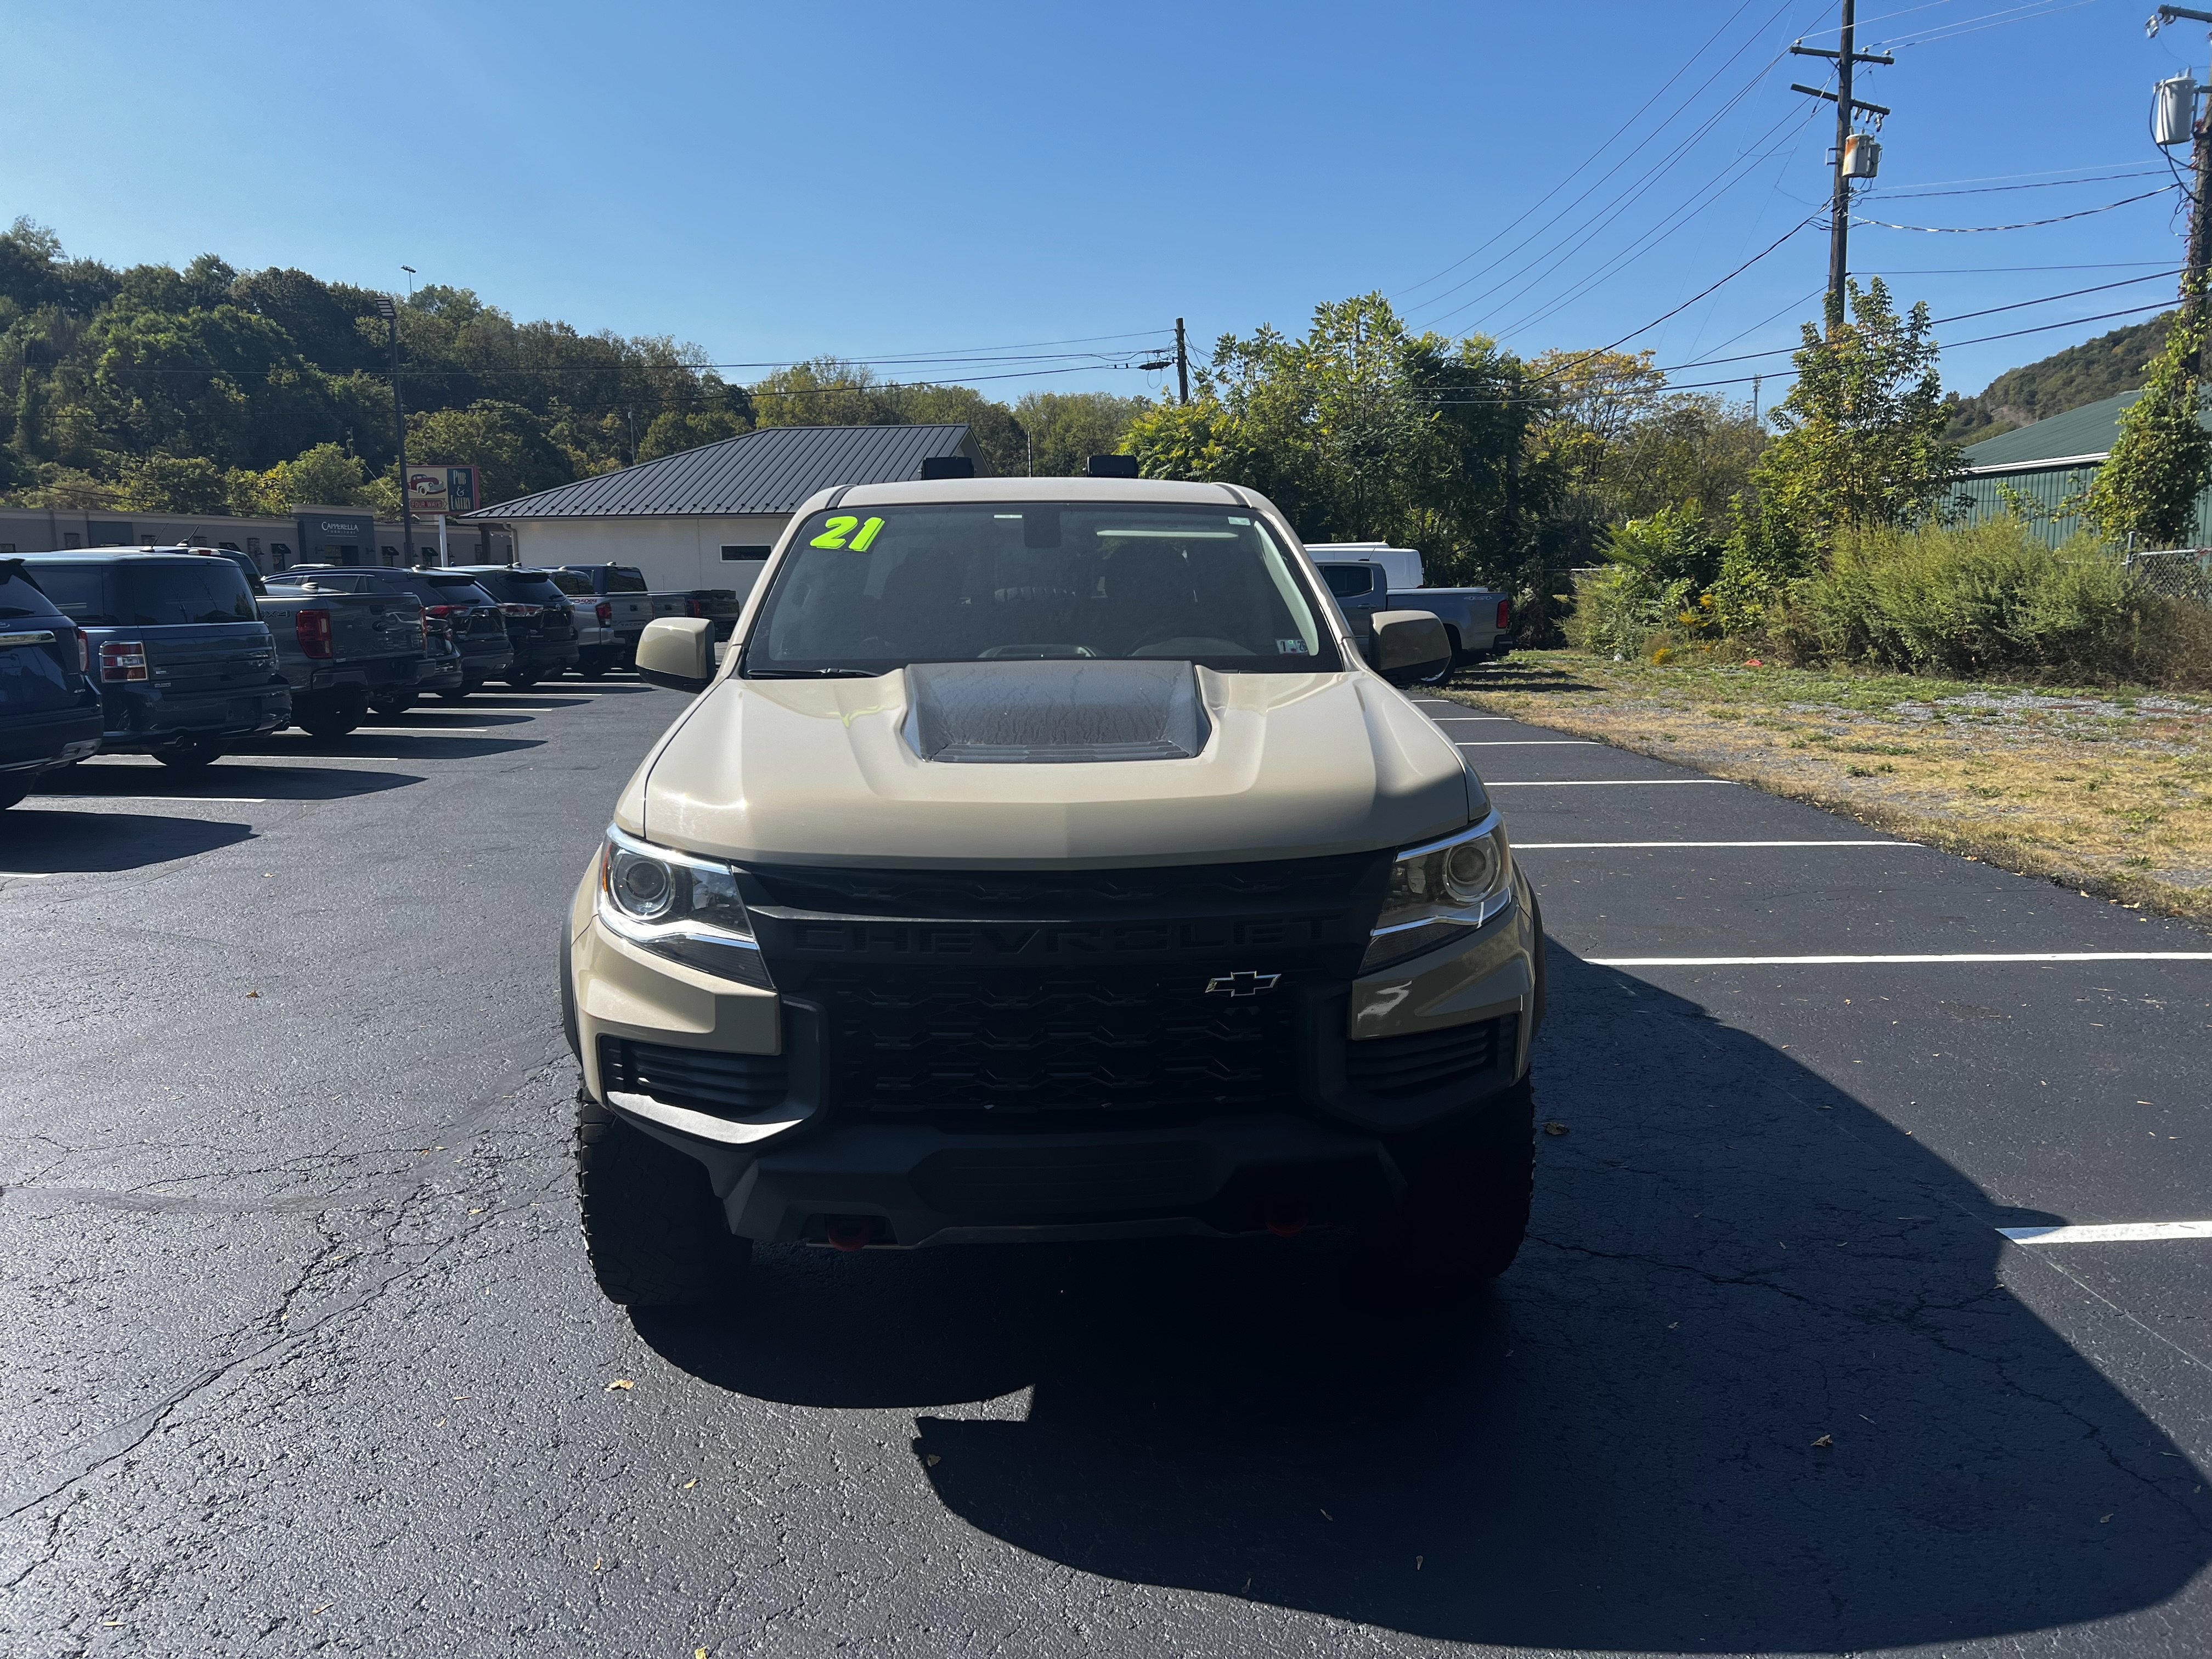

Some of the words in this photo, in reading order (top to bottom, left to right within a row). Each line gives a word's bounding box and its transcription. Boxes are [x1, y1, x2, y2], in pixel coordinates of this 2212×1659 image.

[453, 469, 467, 485] PUB
[456, 486, 465, 496] &
[450, 494, 471, 510] EATERY
[321, 521, 359, 532] CAPPERELLA
[810, 516, 885, 552] 21
[793, 912, 1344, 955] CHEVROLET
